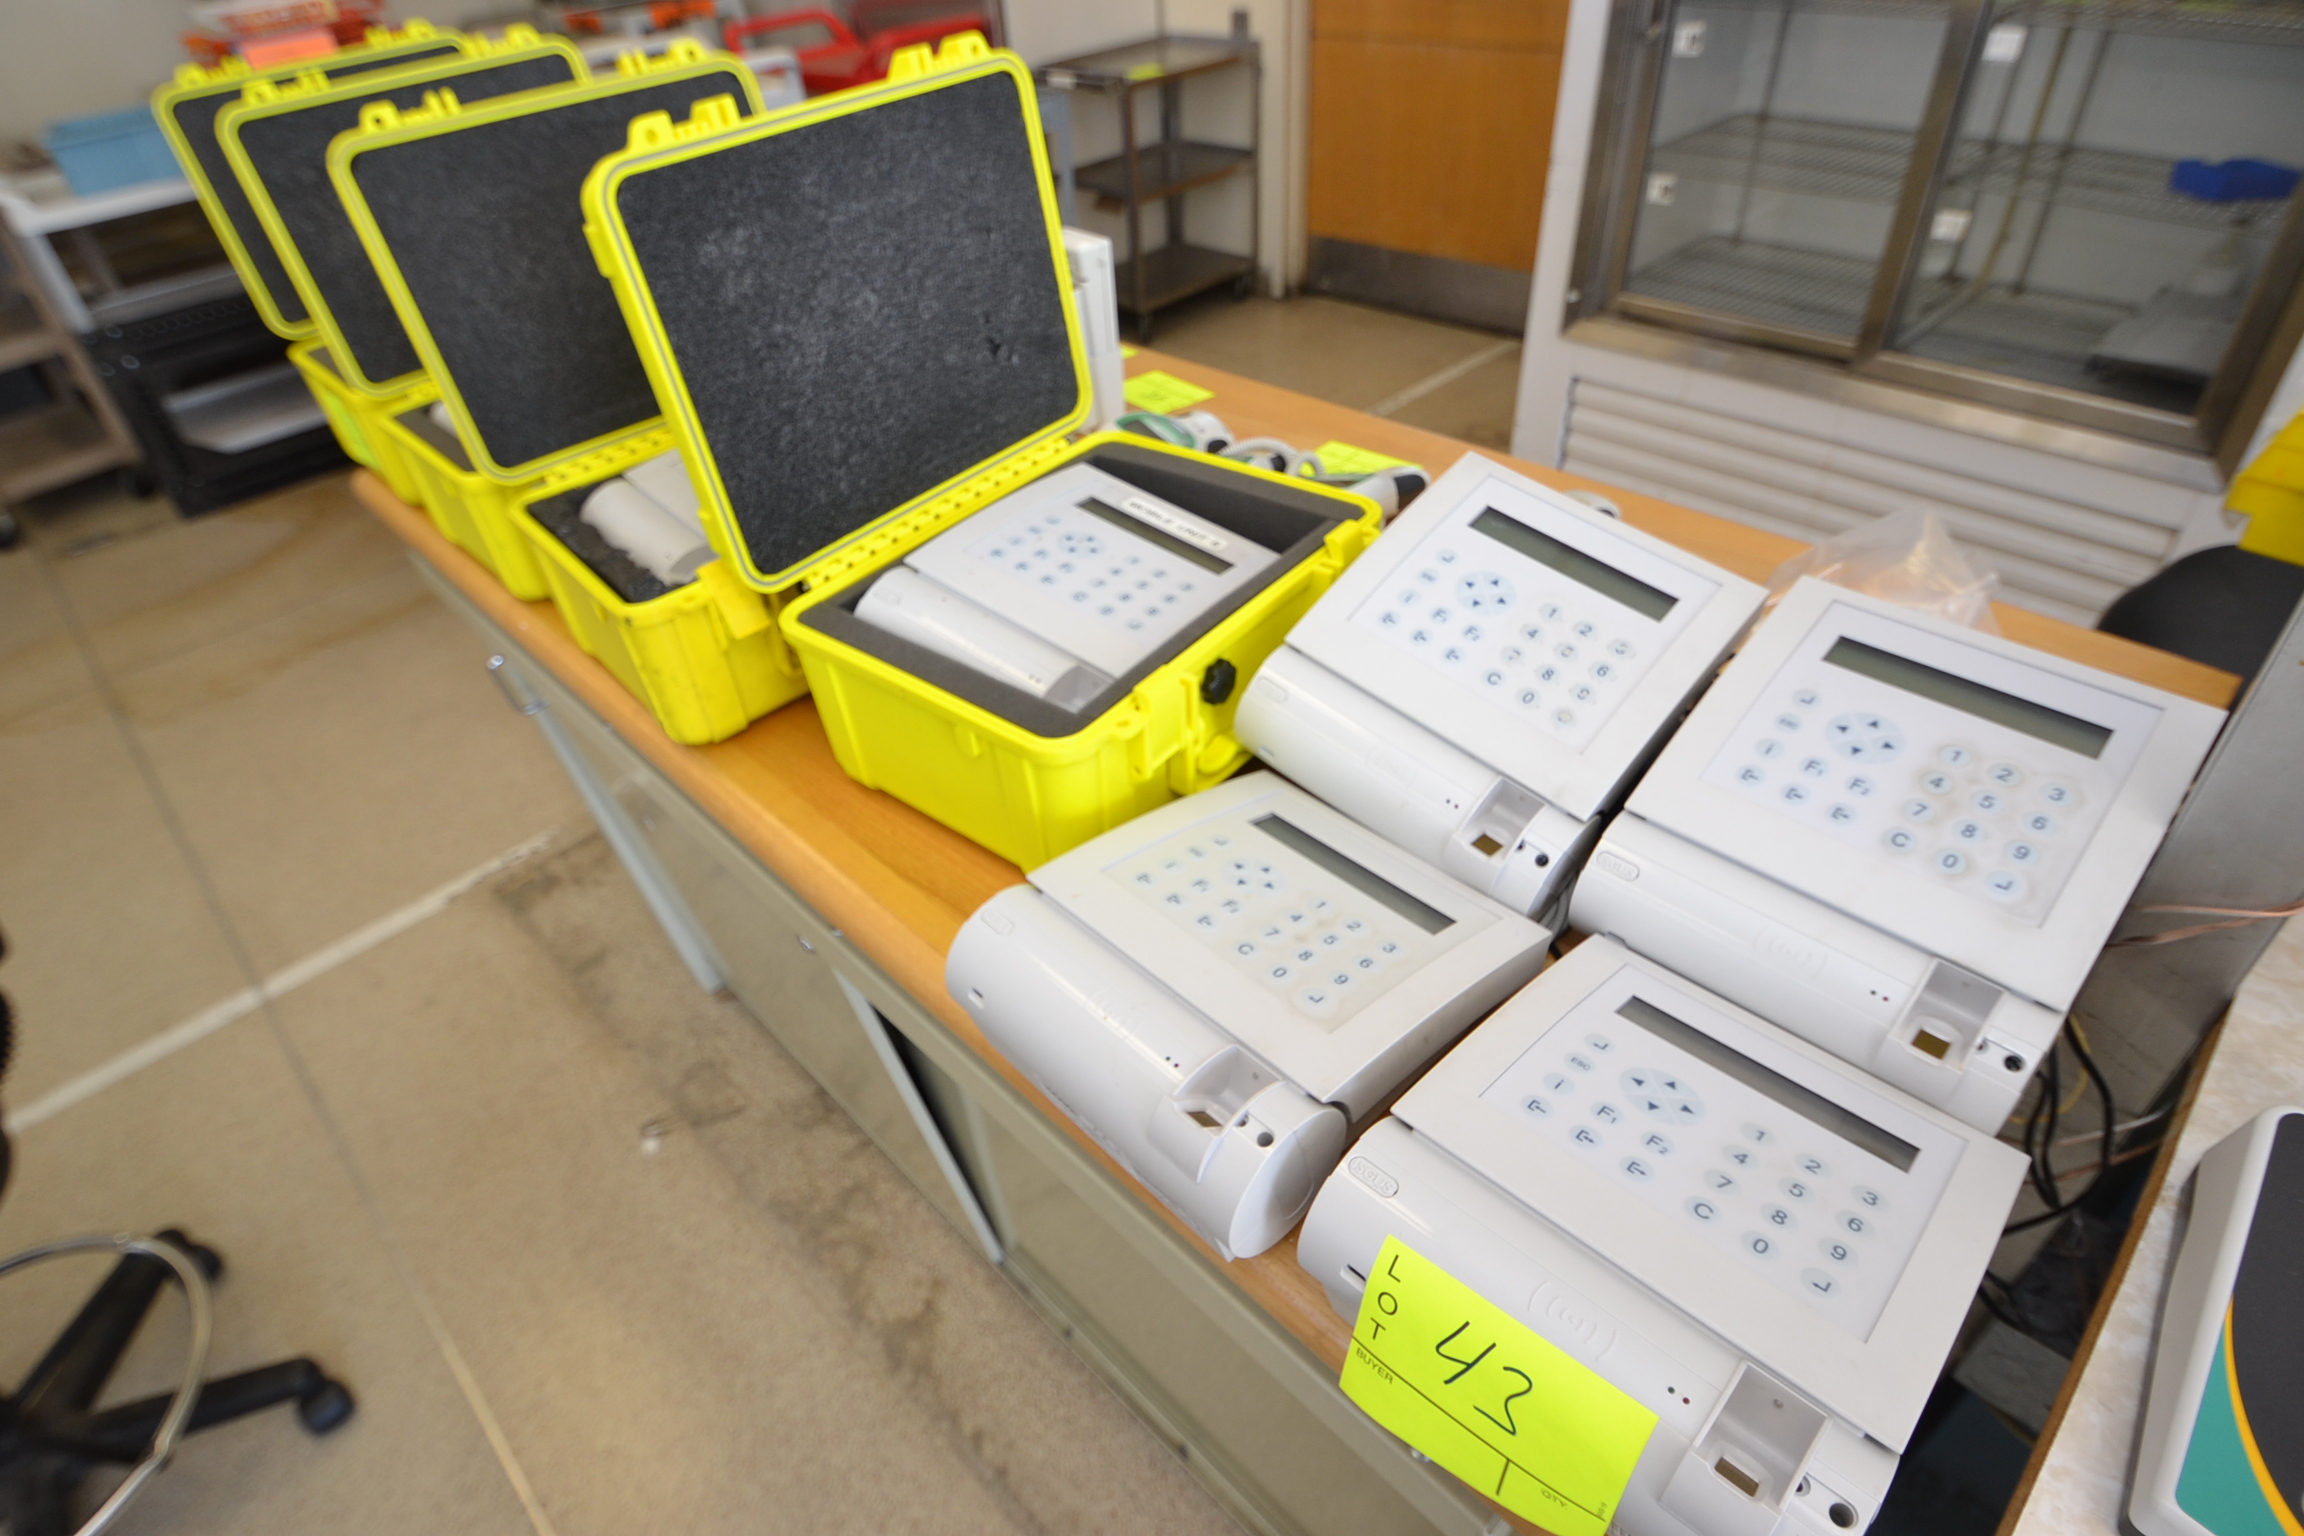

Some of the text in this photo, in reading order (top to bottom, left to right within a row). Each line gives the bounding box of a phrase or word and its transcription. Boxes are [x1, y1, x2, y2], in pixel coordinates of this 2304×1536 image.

[1528, 629, 1538, 638] 4
[1579, 625, 1592, 636] 2
[1542, 669, 1554, 680] 8
[1597, 666, 1609, 676] 6
[1487, 672, 1501, 685] C
[1522, 692, 1534, 704] 0
[1952, 751, 1961, 761] 1
[1996, 768, 2013, 781] 2
[1930, 778, 1943, 787] 4
[2049, 788, 2065, 801] 3
[1980, 795, 1994, 808] 5
[1913, 804, 1928, 815] 7
[2032, 817, 2047, 830] 6
[1961, 824, 1977, 838] 8
[1891, 833, 1909, 847] C
[2014, 846, 2030, 859] 9
[1943, 854, 1958, 868] 0
[1266, 928, 1279, 936] 7
[1347, 922, 1361, 931] 2
[1324, 935, 1337, 945] 5
[1238, 944, 1254, 955] C
[1383, 944, 1396, 953] 3
[1299, 951, 1313, 961] 8
[1360, 959, 1373, 968] 6
[1273, 968, 1287, 977] 0
[1335, 975, 1348, 984] 9
[1597, 1105, 1618, 1124] F1
[1757, 1131, 1765, 1141] 1
[1646, 1135, 1669, 1155] F2
[1734, 1154, 1748, 1164] 4
[1805, 1160, 1821, 1174] 2
[1717, 1176, 1732, 1188] 7
[1789, 1183, 1805, 1197] 5
[1863, 1192, 1878, 1205] 3
[1694, 1203, 1713, 1219] C
[1772, 1210, 1787, 1225] 8
[1848, 1218, 1863, 1232] 6
[1753, 1239, 1768, 1254] 0
[1831, 1245, 1847, 1260] 9
[1356, 1347, 1394, 1385] BUYER
[1435, 1320, 1532, 1436] 43
